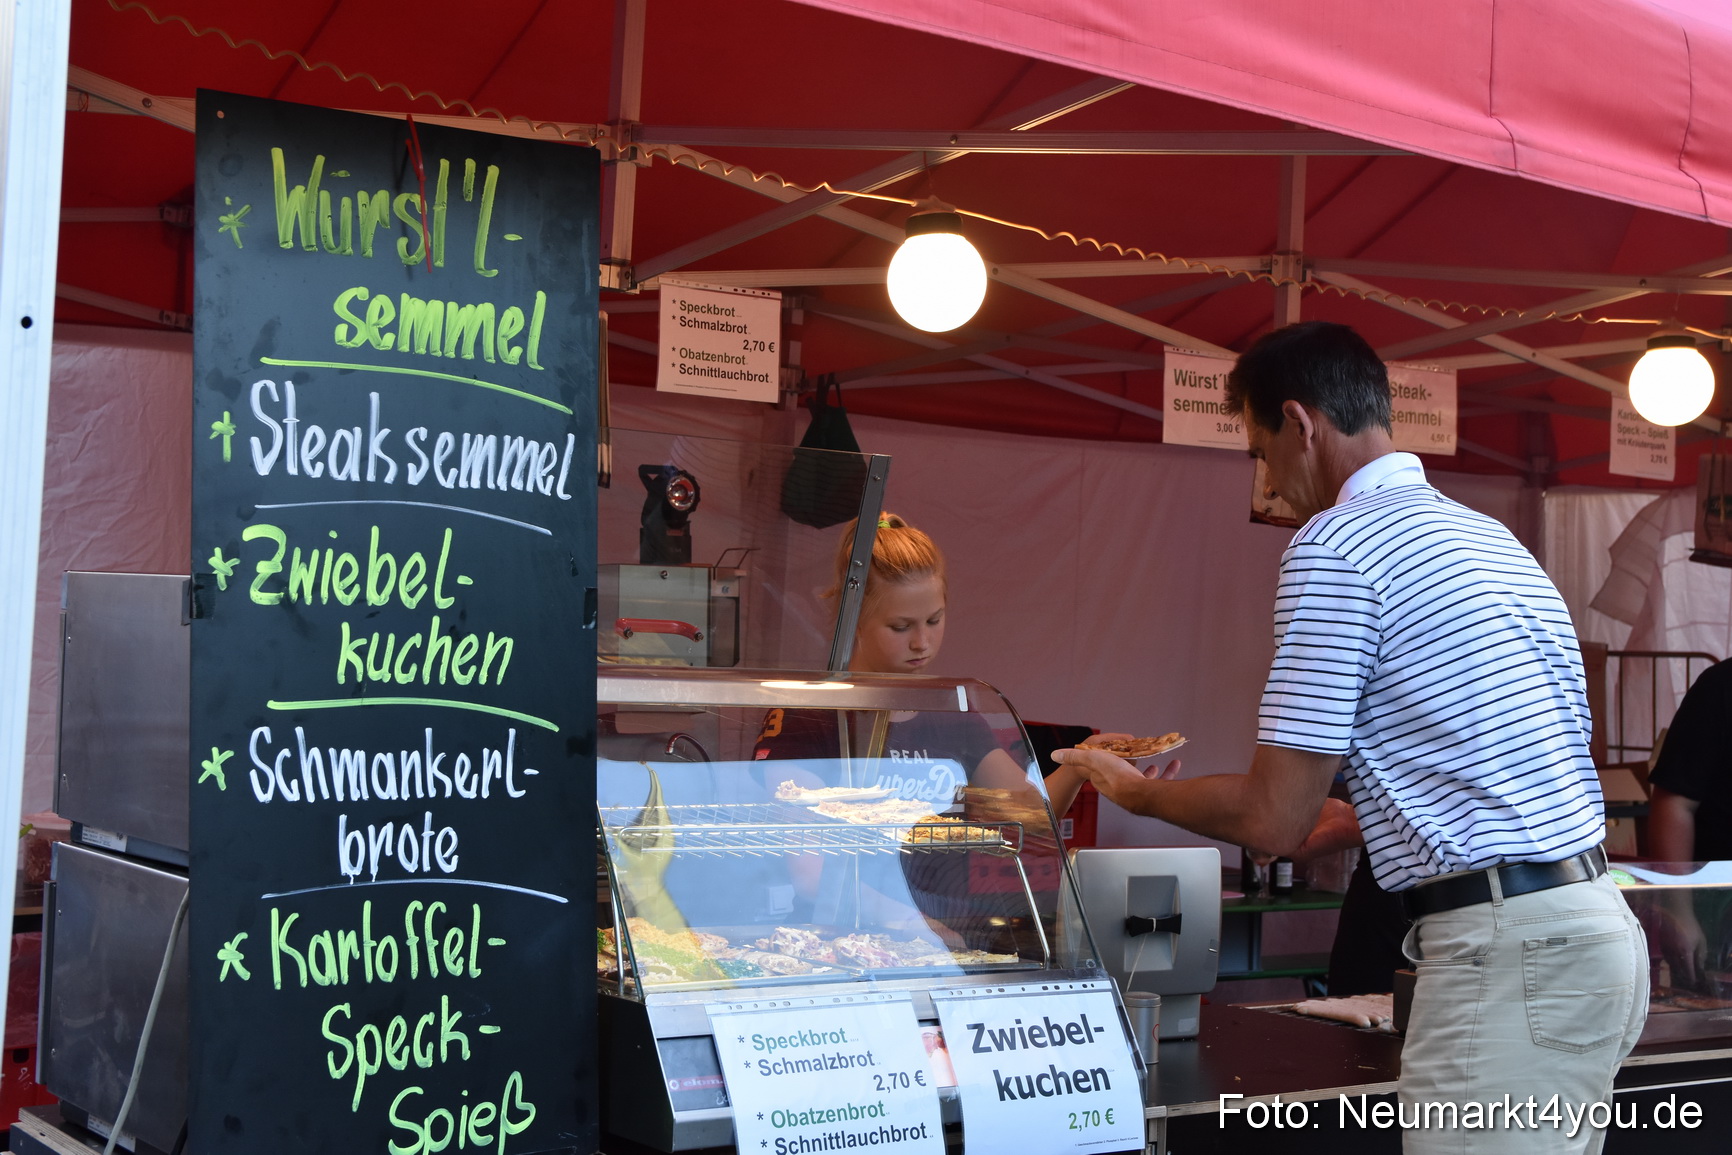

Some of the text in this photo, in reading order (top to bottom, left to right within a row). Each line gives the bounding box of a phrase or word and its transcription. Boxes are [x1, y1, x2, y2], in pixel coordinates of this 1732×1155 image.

[679, 300, 736, 318] Speckbrot
[333, 286, 546, 370] semmel
[679, 315, 748, 335] Schmalzbrot
[679, 347, 746, 366] Obatzenbrot
[743, 339, 775, 353] 2,70 €
[679, 363, 769, 384] Schnittlauchbrot
[1389, 381, 1432, 401] Steak-
[1173, 398, 1229, 416] semme
[1390, 409, 1442, 427] semmel
[1216, 422, 1233, 434] 3,00
[242, 524, 473, 609] Zwiebel-
[336, 615, 514, 685] kuchen
[249, 726, 539, 803] Schmankerl-
[889, 749, 935, 764] REAL
[338, 811, 459, 884] brote
[271, 900, 506, 990] Kartoffel-
[750, 1028, 848, 1054] Speckbrot
[965, 1013, 1105, 1055] Zwiebel-
[322, 994, 501, 1112] Speck-
[757, 1050, 876, 1077] Schmalzbrot
[872, 1069, 927, 1094] 2,70 €
[992, 1064, 1112, 1102] kuchen
[388, 1070, 537, 1155] Spieß
[770, 1100, 886, 1129] Obatzenbrot
[1067, 1108, 1115, 1132] 2,70 €
[774, 1122, 928, 1155] Schnittlauchbrot
